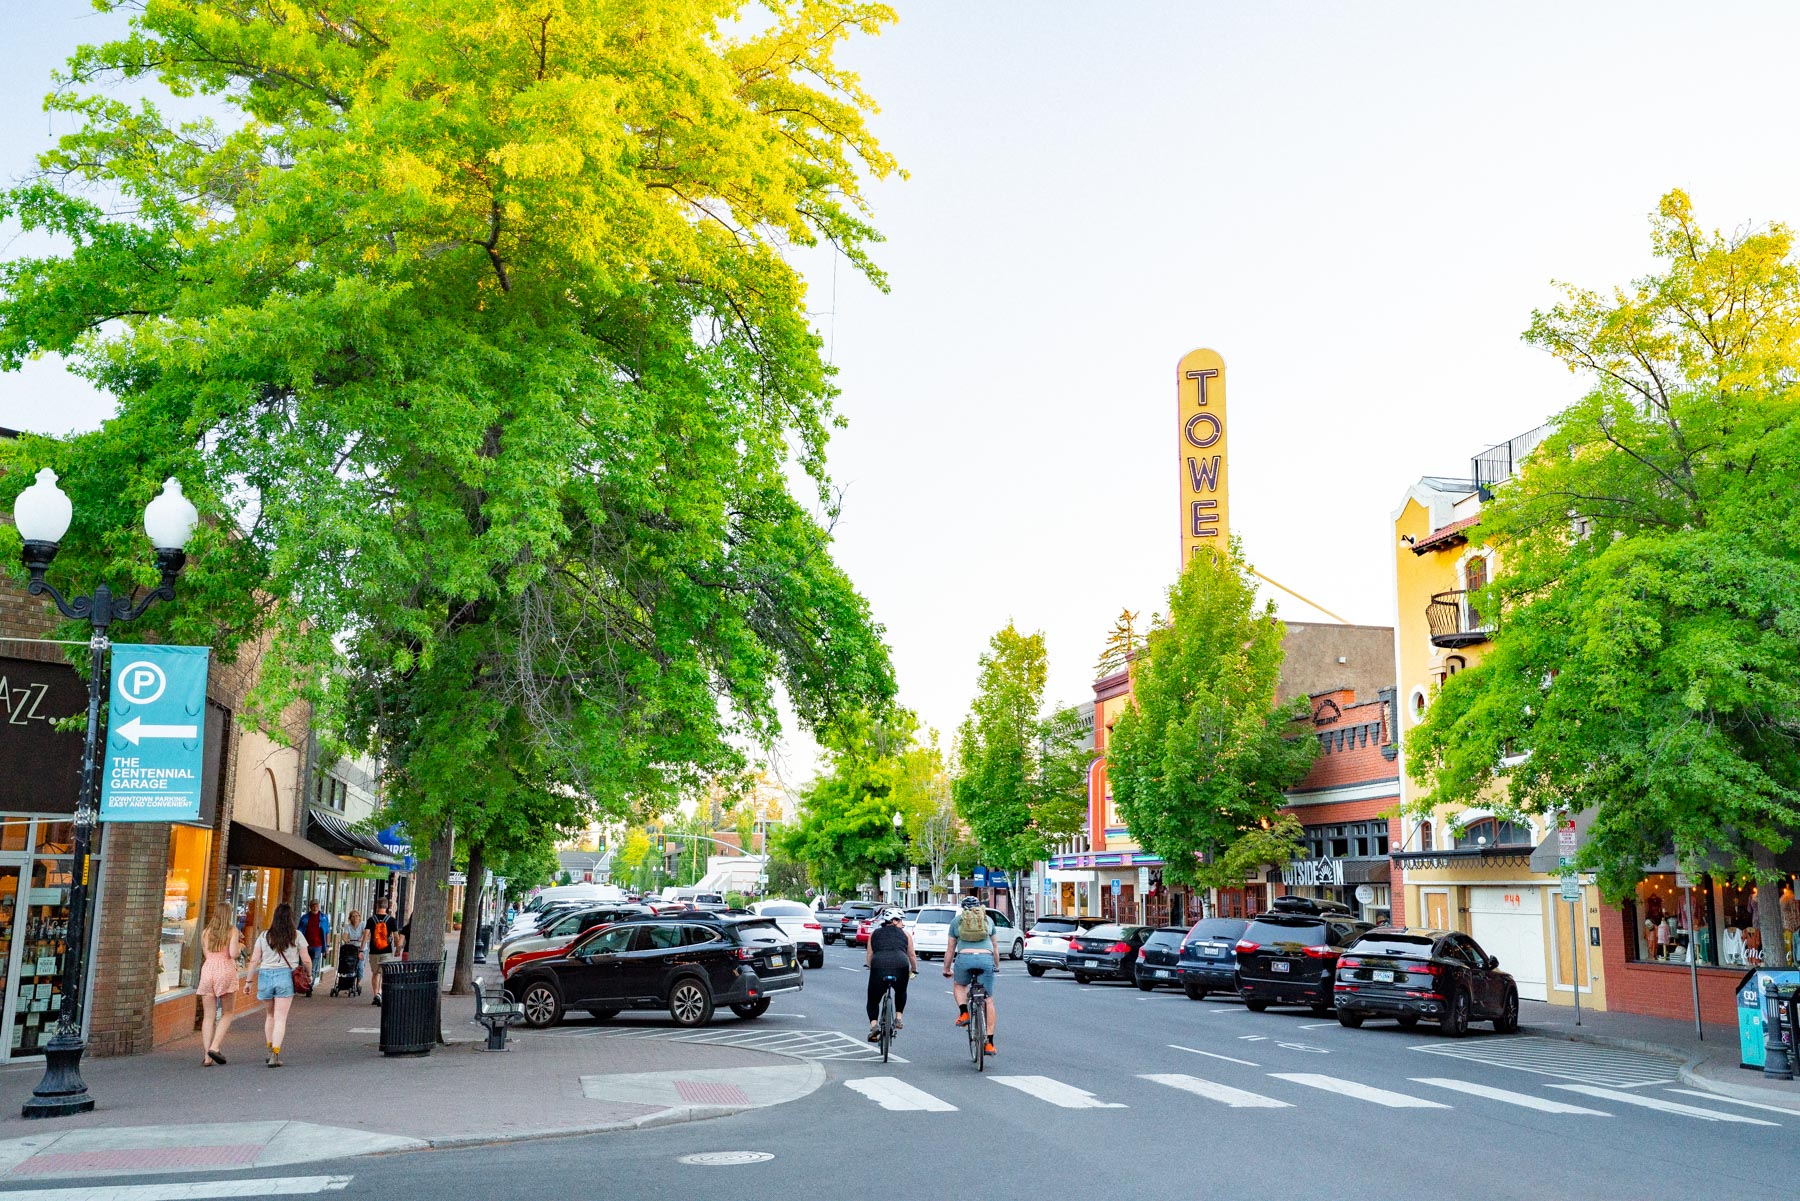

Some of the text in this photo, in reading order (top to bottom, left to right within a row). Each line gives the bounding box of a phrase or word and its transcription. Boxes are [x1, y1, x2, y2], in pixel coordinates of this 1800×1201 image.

[133, 670, 156, 695] P
[112, 757, 140, 768] THE
[112, 768, 195, 779] CENTENNIAL
[110, 779, 168, 789] GARAGE
[1281, 860, 1344, 885] OUTSIDE IN
[1743, 990, 1758, 1001] GO!
